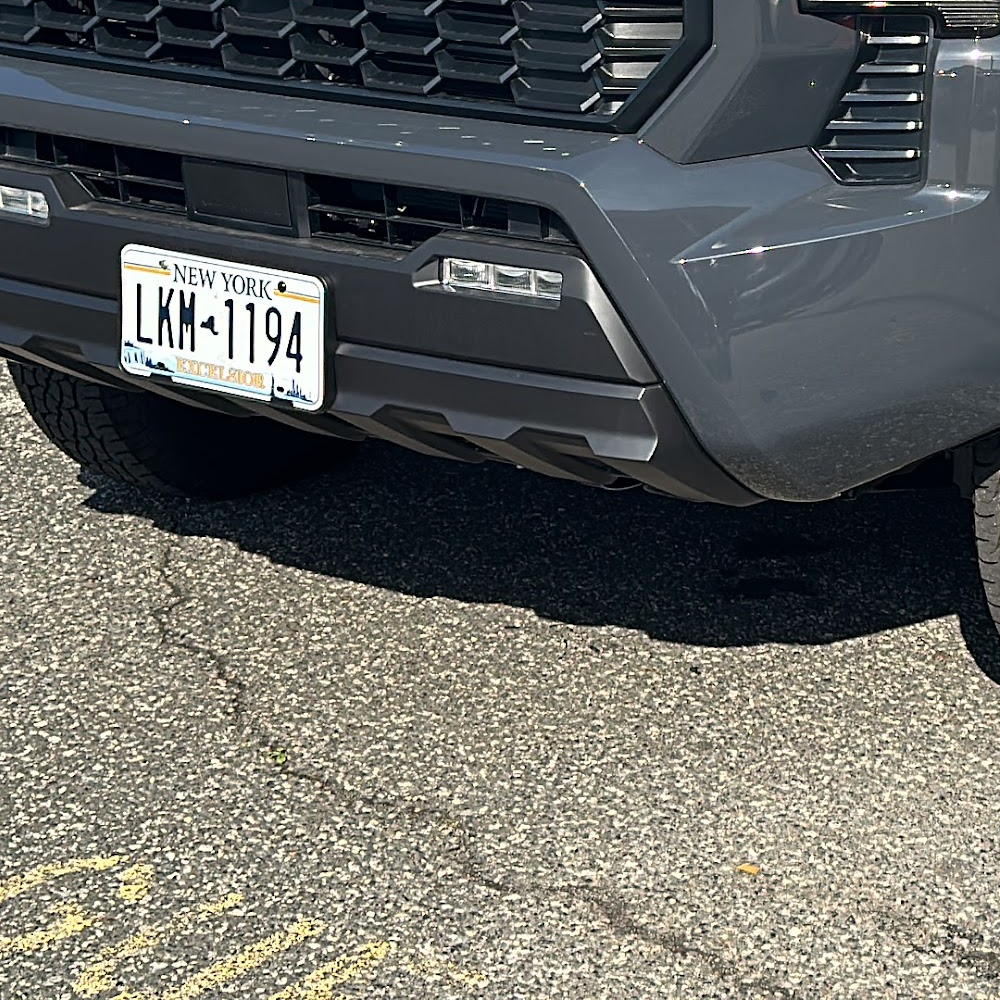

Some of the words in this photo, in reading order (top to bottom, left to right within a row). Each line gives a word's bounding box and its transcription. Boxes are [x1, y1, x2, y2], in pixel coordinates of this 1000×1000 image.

[173, 263, 217, 290] NEW
[220, 272, 273, 301] YORK
[176, 356, 266, 390] EXCELSIOR
